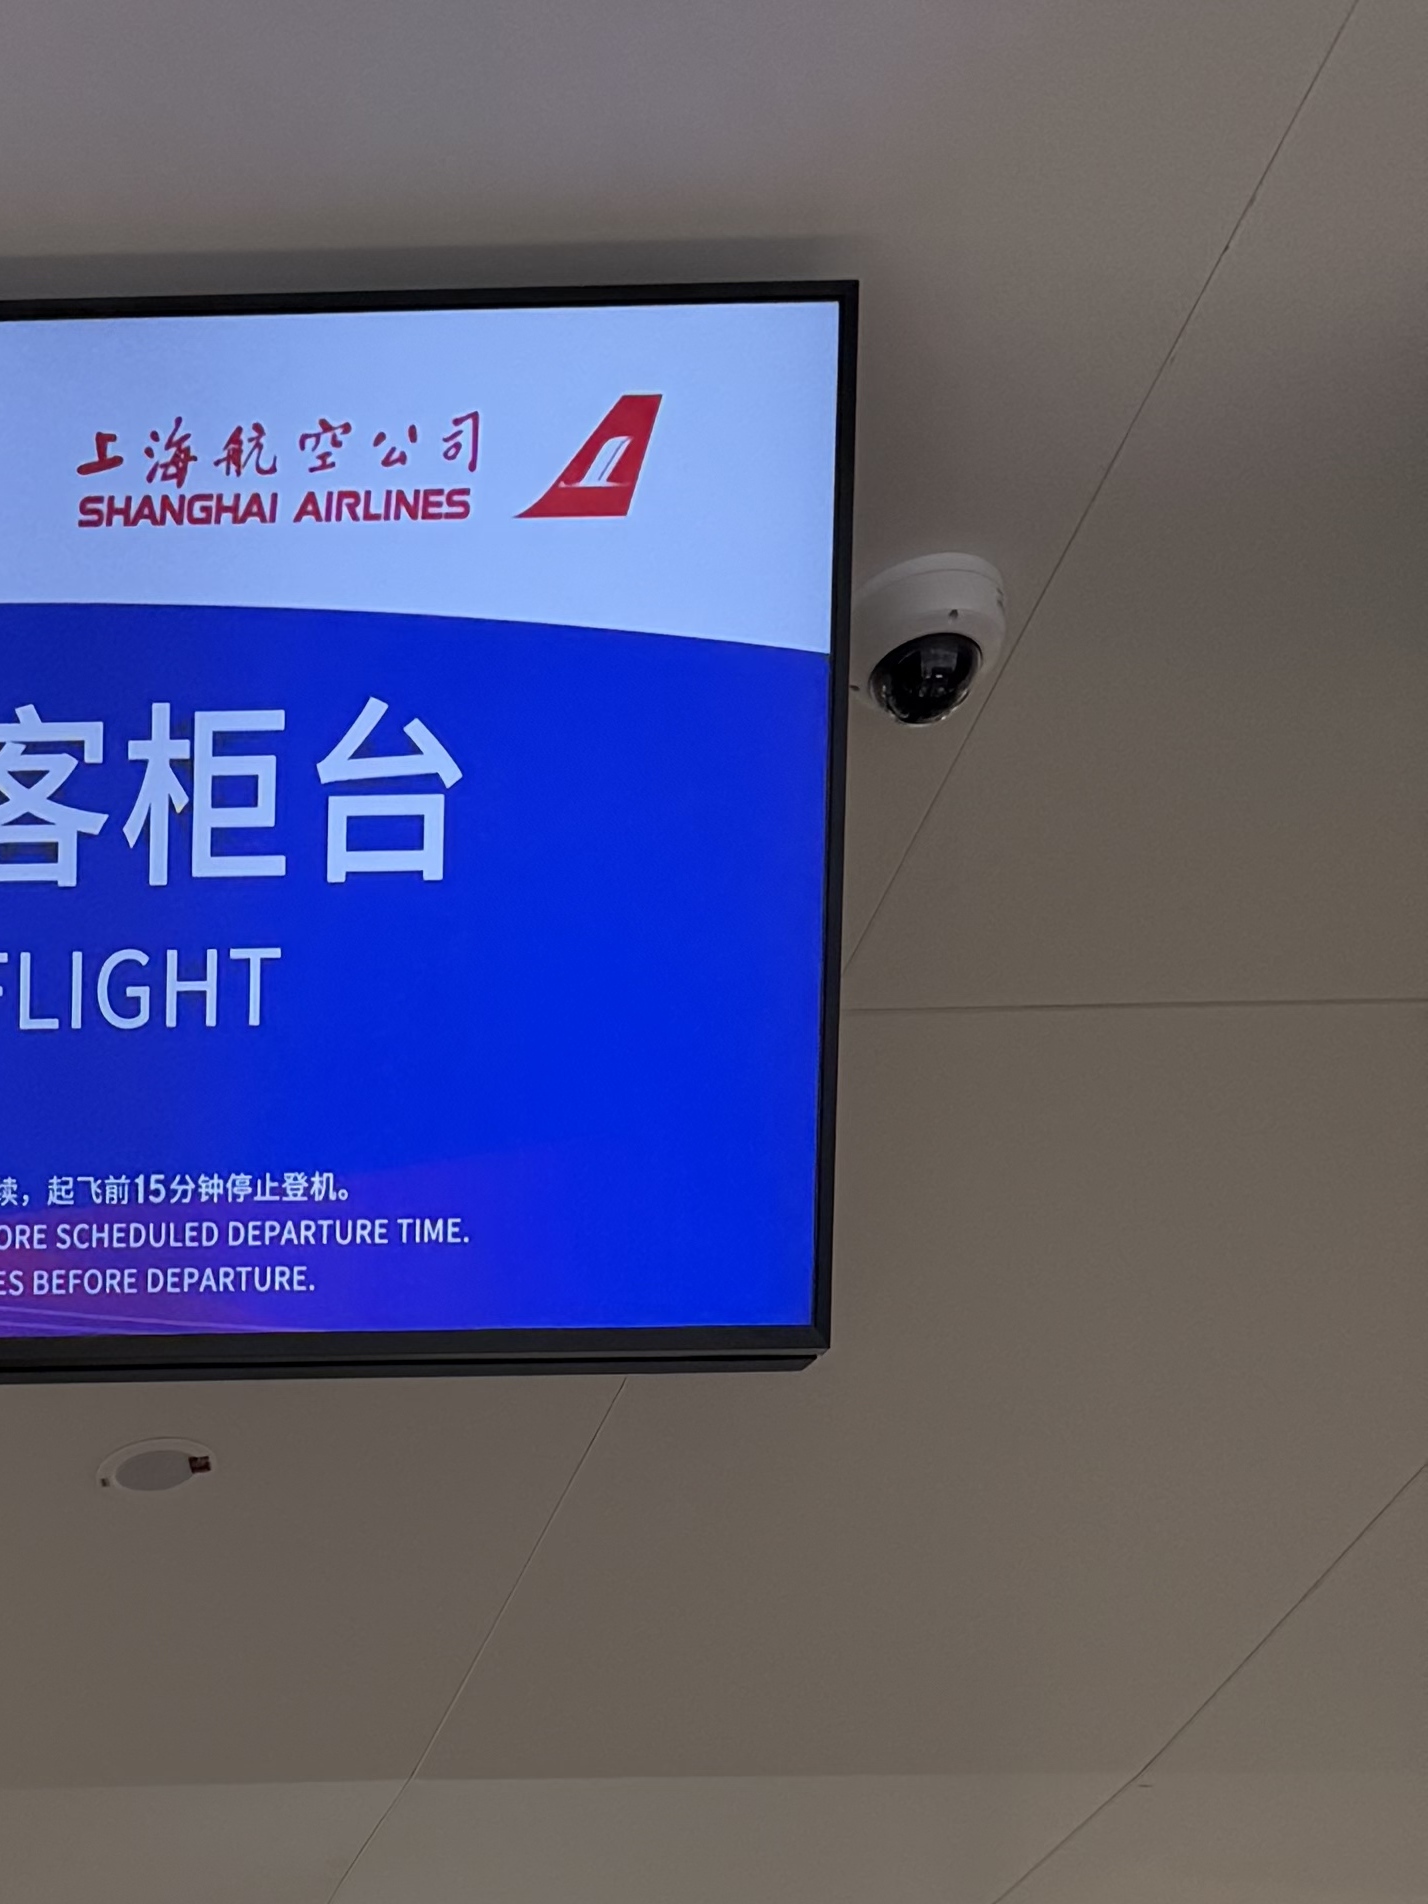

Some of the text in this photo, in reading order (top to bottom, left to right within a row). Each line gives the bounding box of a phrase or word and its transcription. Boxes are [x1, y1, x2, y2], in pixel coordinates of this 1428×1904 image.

[76, 411, 481, 488] 上海航空公司
[77, 488, 471, 527] SHANGHAI AIRLINES
[55, 1221, 219, 1250] SCHEDULED
[228, 1218, 389, 1247] DEPARTURE
[397, 1217, 471, 1245] TIME.
[32, 1267, 139, 1296] BEFORE
[146, 1265, 316, 1294] DEPARTURE.
